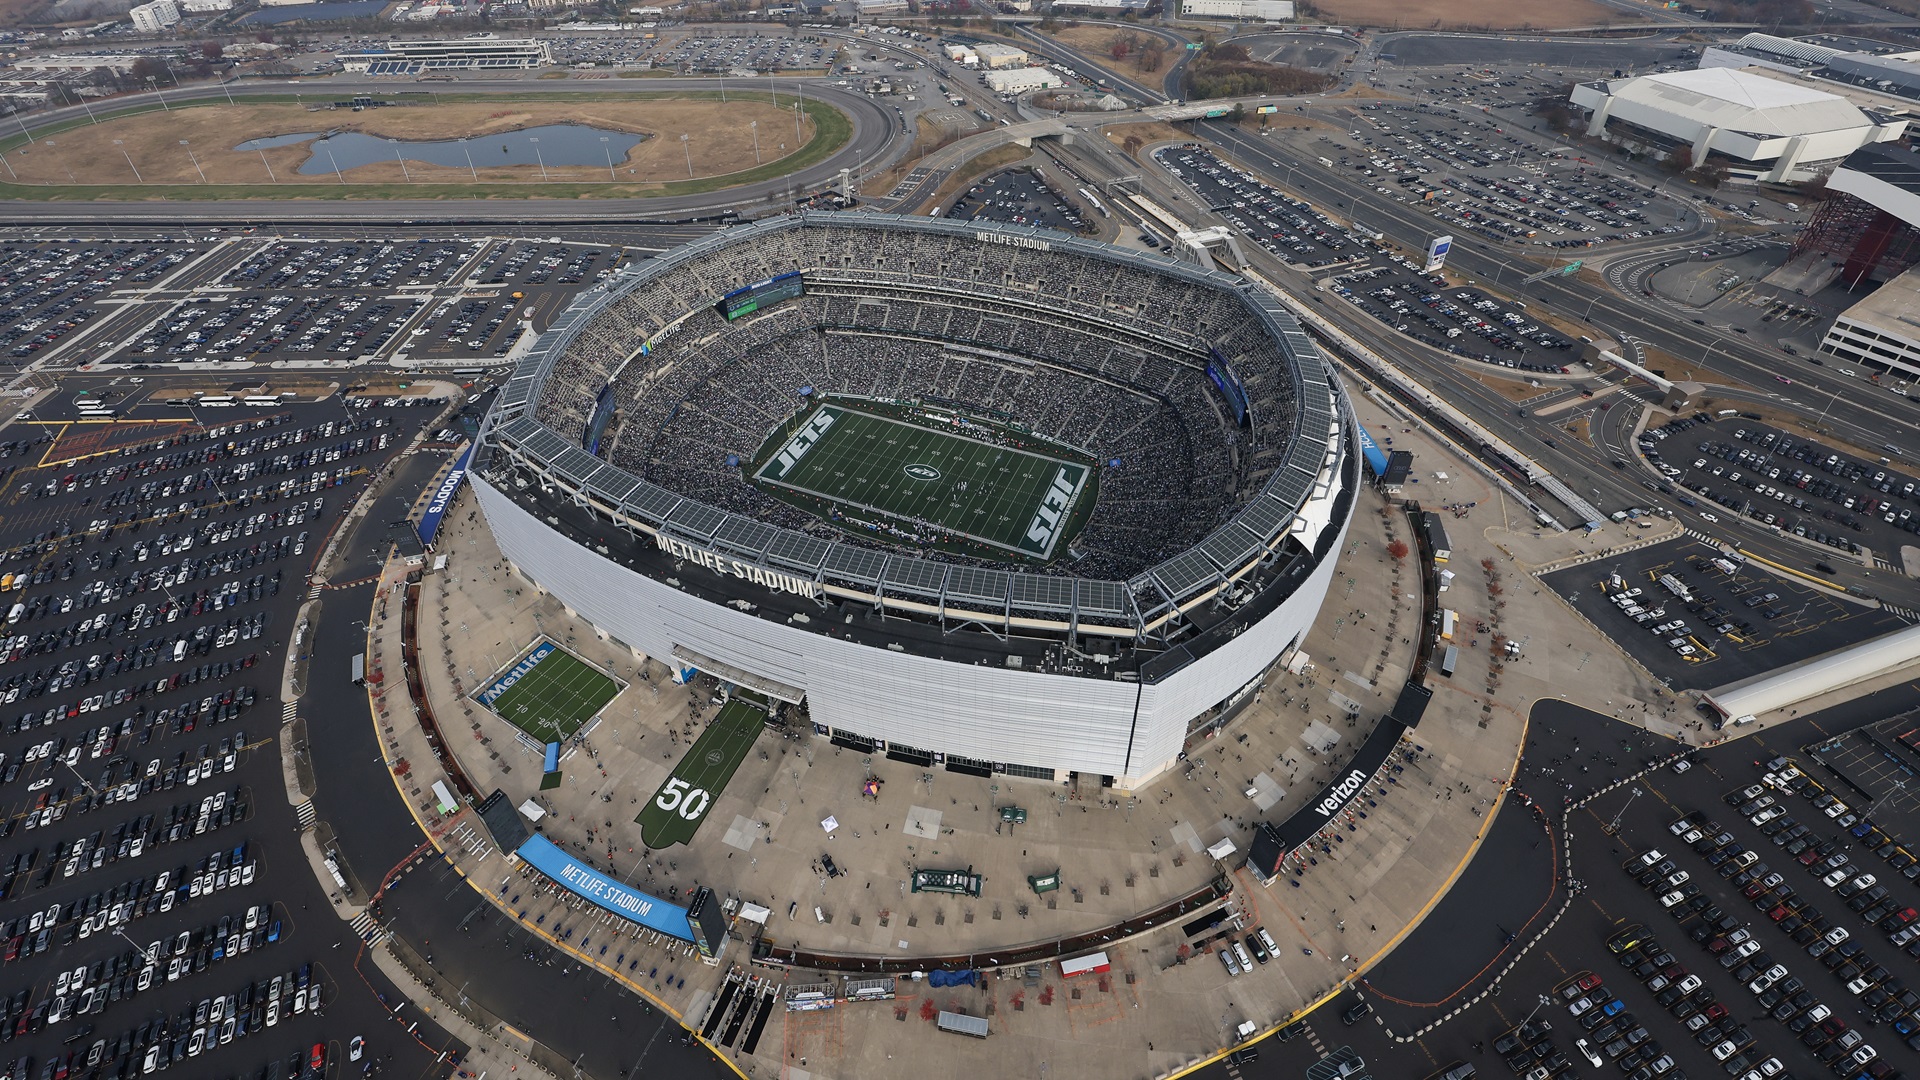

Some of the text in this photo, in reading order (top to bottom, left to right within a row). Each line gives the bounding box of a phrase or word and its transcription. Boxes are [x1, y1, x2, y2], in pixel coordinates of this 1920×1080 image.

[977, 232, 1049, 251] METLIFE STADIUM
[650, 324, 681, 348] MetLife
[777, 410, 834, 477] JETS
[429, 470, 464, 513] MOODY'S
[1027, 468, 1074, 549] JETS
[655, 533, 814, 599] METLIFE STADIUM
[486, 649, 548, 700] MetLife
[656, 777, 710, 820] 50
[1314, 769, 1367, 817] verizon
[560, 864, 653, 917] METLIFE STADIUM
